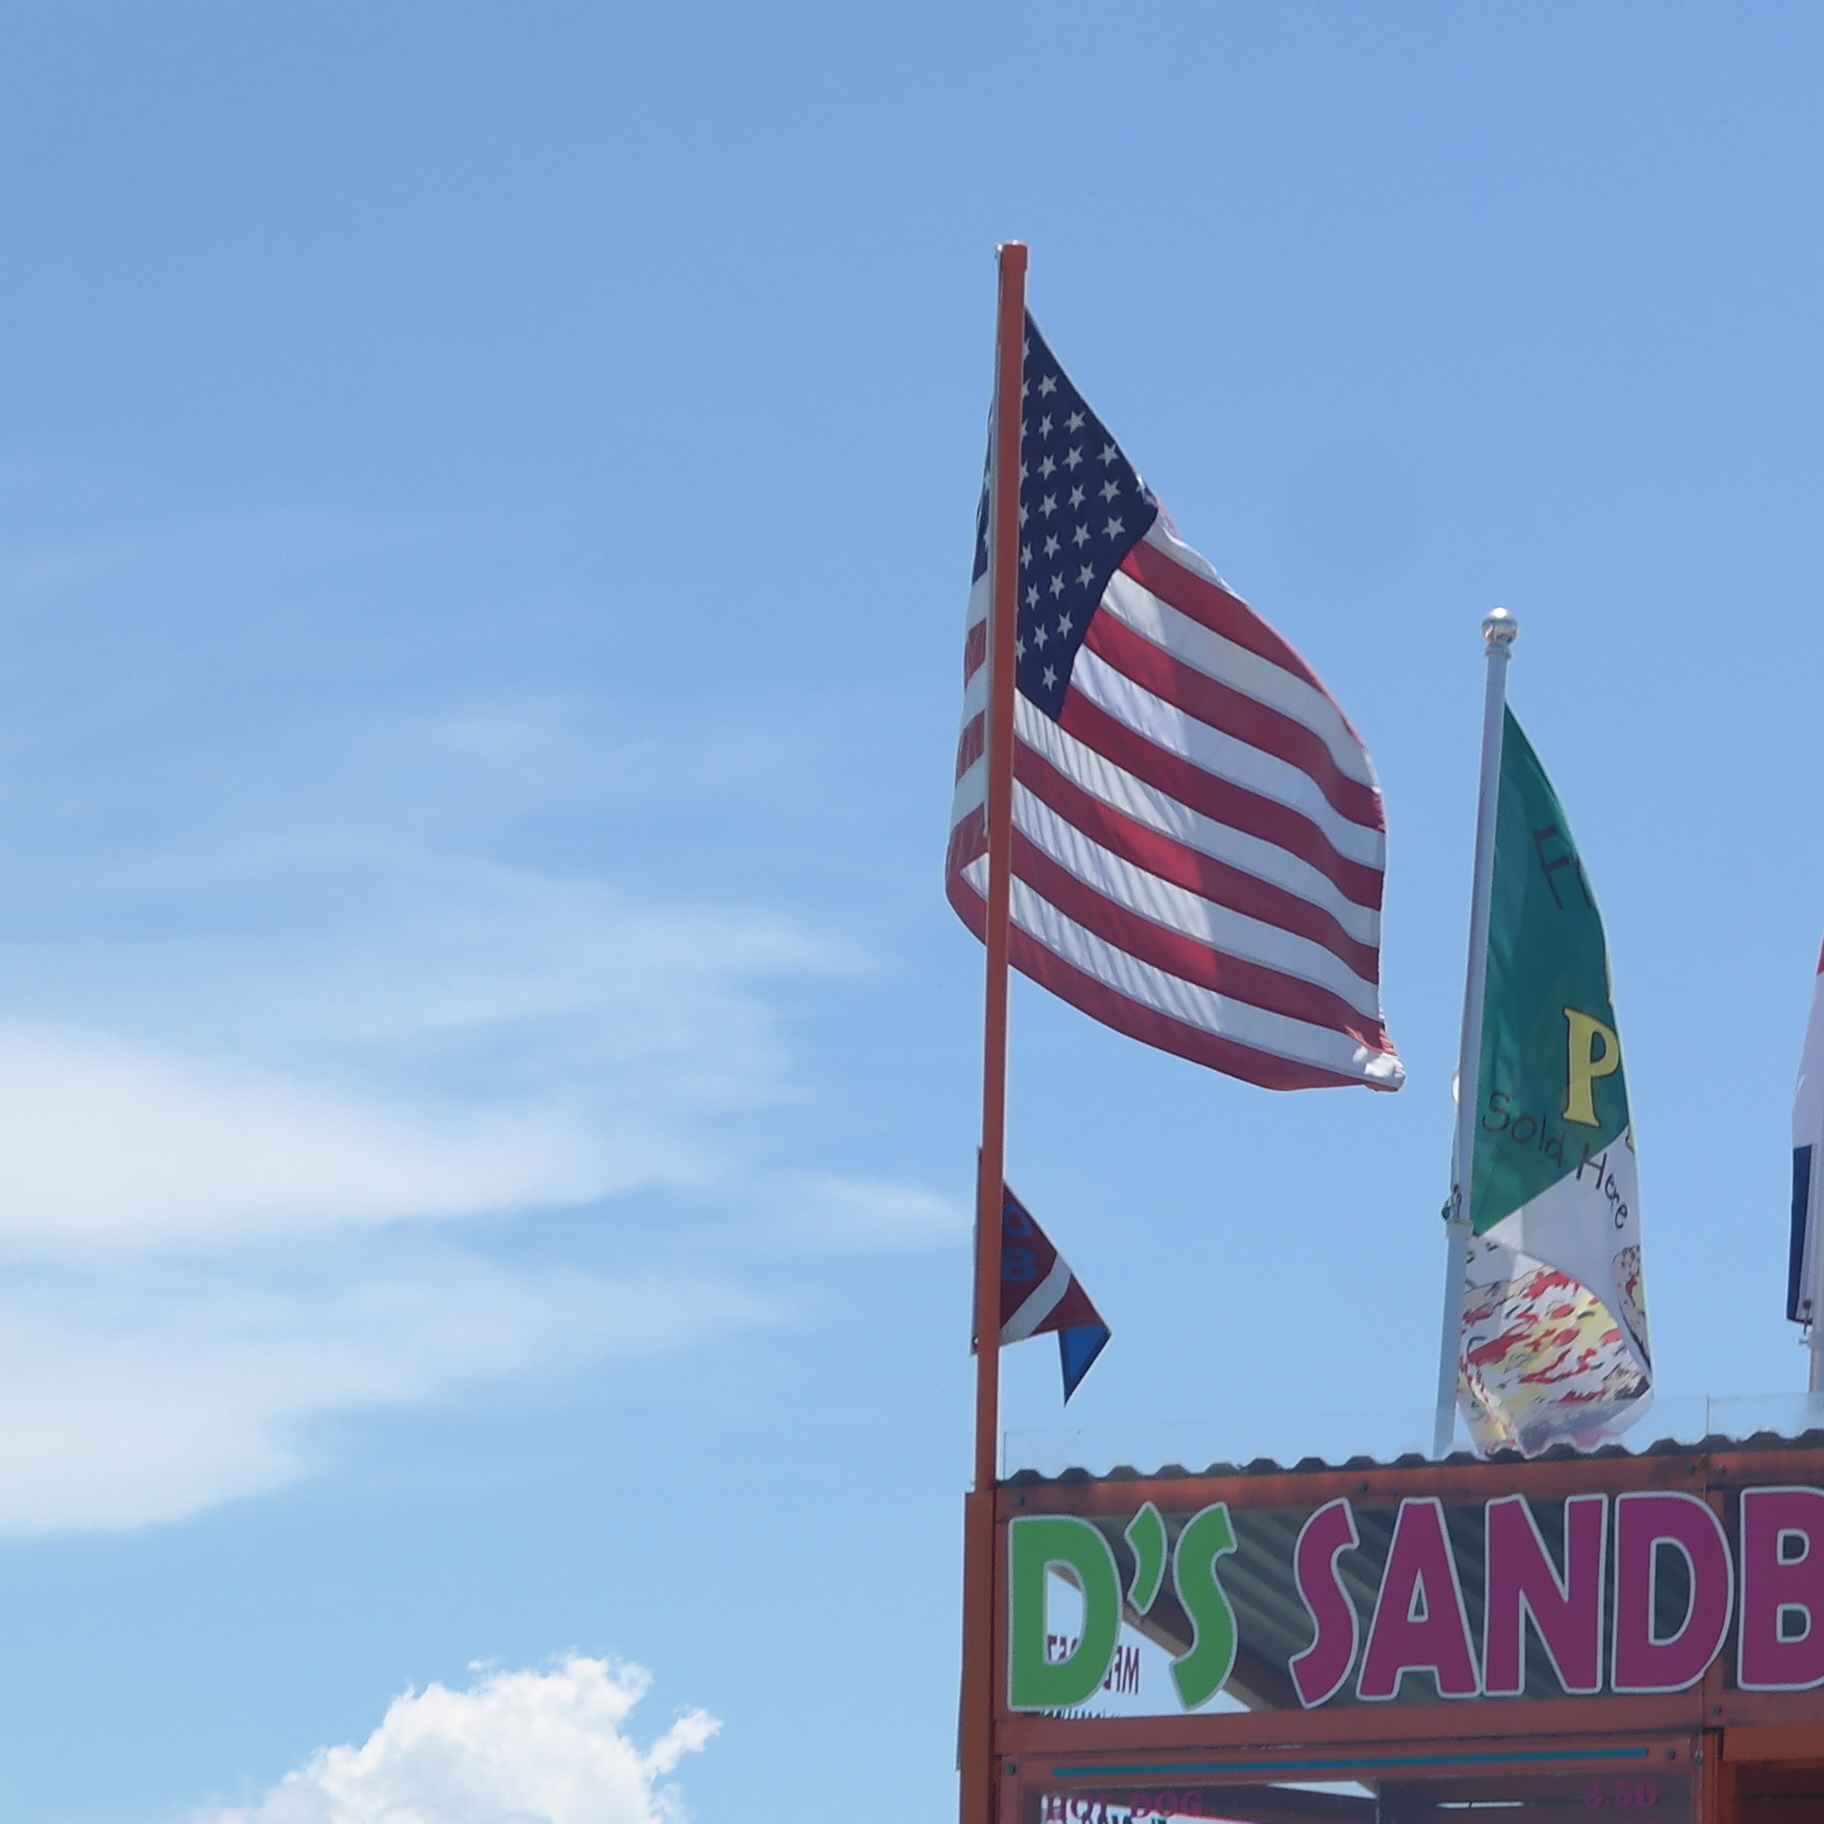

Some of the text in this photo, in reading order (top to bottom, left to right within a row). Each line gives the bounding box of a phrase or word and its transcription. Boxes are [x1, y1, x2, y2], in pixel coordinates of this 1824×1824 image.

[1481, 1090, 1629, 1231] Sold Here
[1007, 1500, 1239, 1712] D'S
[1045, 1793, 1114, 1821] HOT
[1130, 1790, 1204, 1818] DOG
